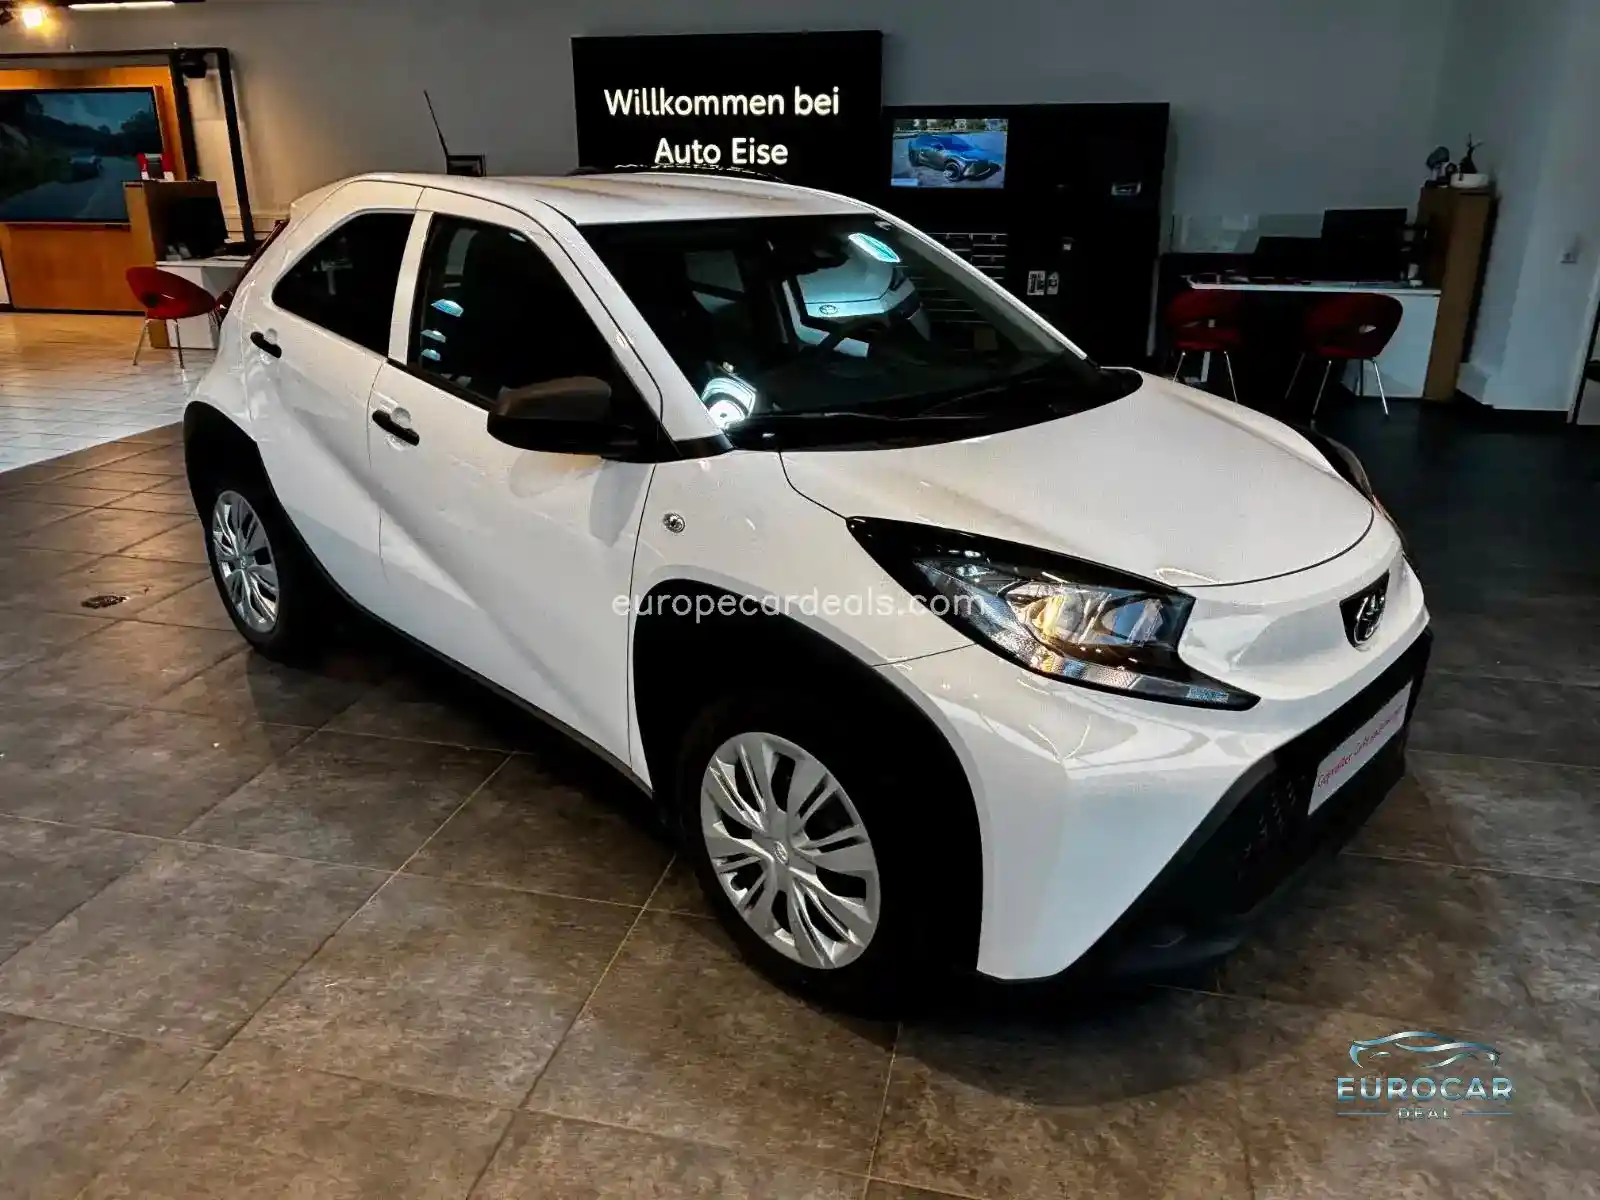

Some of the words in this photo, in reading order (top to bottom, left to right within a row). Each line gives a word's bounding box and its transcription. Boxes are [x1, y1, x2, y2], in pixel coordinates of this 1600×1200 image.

[603, 86, 785, 116] Willkommen
[794, 86, 840, 115] bei
[654, 137, 722, 165] Auto
[731, 137, 789, 165] Eise
